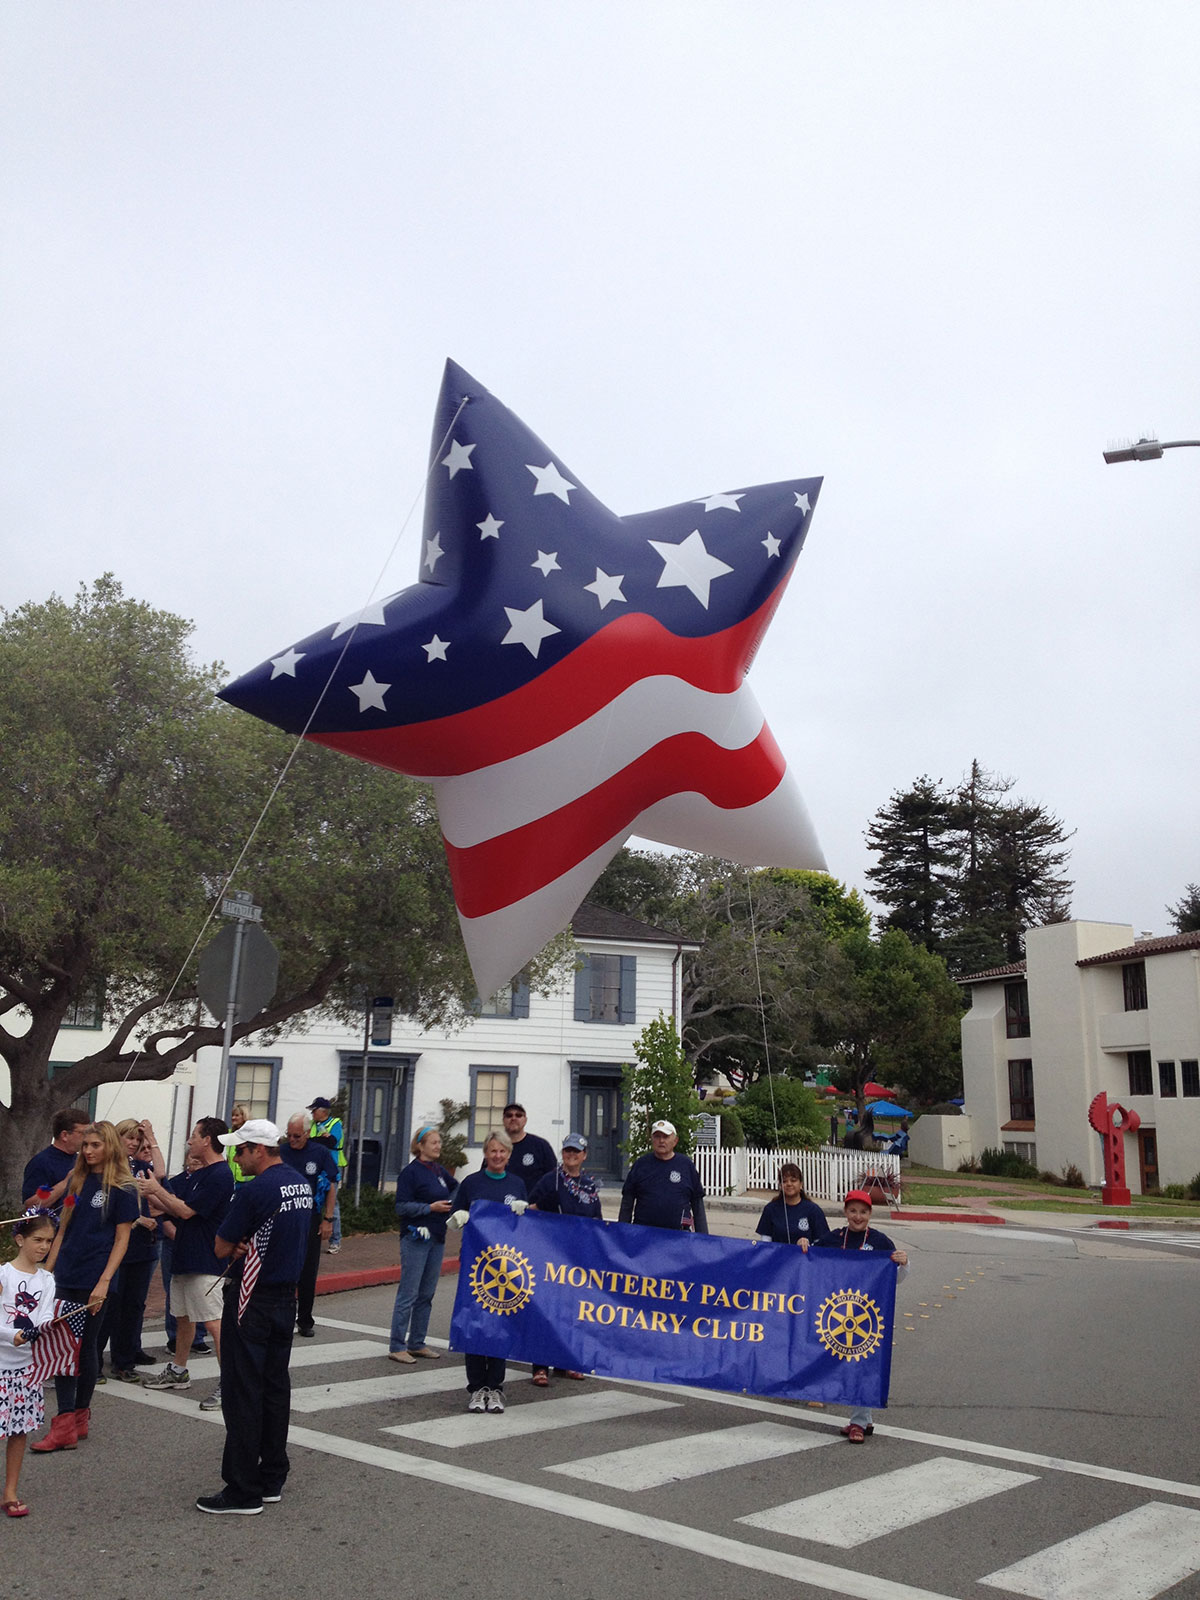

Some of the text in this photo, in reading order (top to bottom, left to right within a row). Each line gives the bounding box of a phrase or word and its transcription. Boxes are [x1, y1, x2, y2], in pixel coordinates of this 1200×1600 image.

[280, 1184, 313, 1198] ROTAR
[280, 1196, 314, 1213] AT WOR
[544, 1262, 805, 1315] MONTEREY PACIFIC
[836, 1295, 863, 1304] ROTARY
[577, 1300, 765, 1342] ROTARY CLUB
[825, 1333, 874, 1355] INTERNATIONAL
